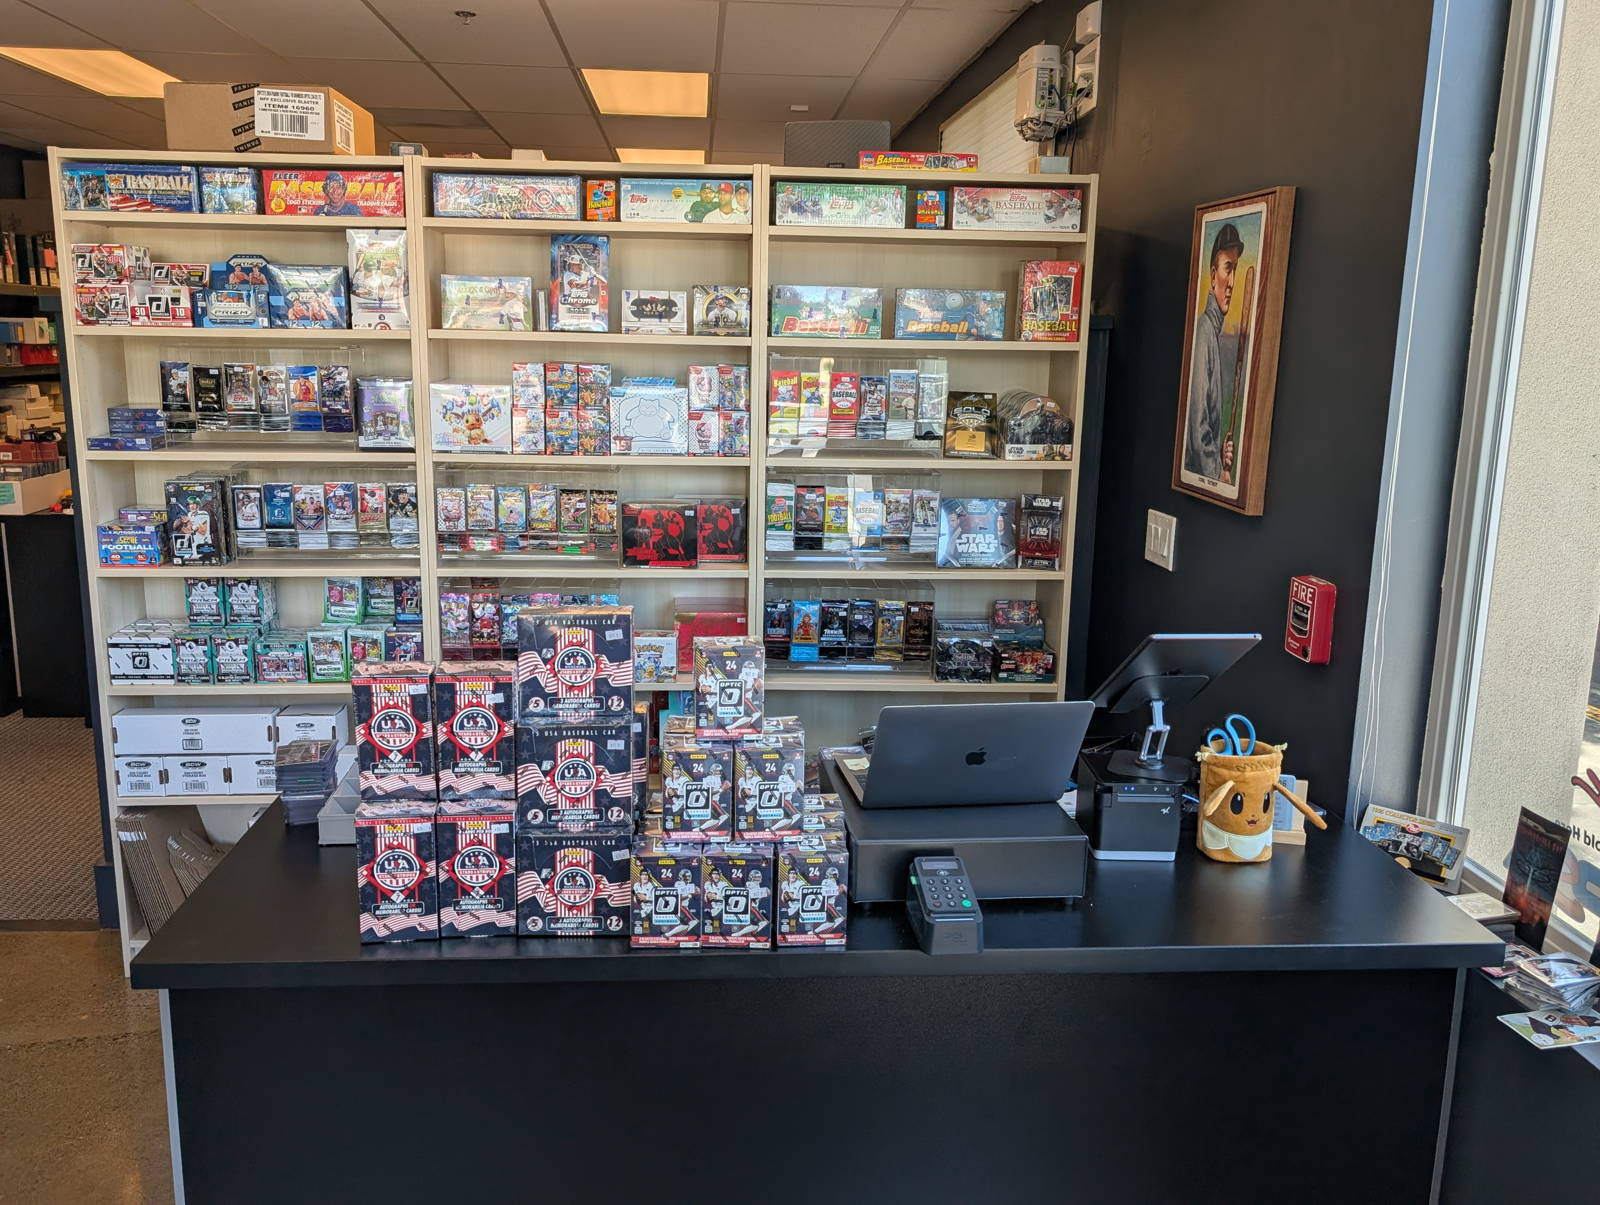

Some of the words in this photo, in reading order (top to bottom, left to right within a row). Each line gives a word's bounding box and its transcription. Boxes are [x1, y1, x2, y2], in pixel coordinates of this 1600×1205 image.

[127, 173, 192, 190] BASEBALL
[995, 201, 1042, 210] BASEBALL
[1022, 320, 1077, 331] BASEBALL
[955, 533, 998, 544] STAR
[956, 543, 998, 553] WARS
[1292, 582, 1314, 605] FIRE
[564, 657, 587, 665] USA
[725, 661, 737, 670] 24
[381, 719, 406, 729] USA
[463, 718, 488, 727] USA
[564, 768, 587, 777] USA
[692, 763, 704, 773] 24
[765, 763, 776, 772] 24
[610, 810, 622, 818] 12
[384, 860, 408, 870] USA
[465, 857, 489, 866] USA
[661, 868, 673, 878] 24
[731, 868, 743, 878] 24
[808, 867, 820, 877] 24
[564, 876, 586, 886] USA
